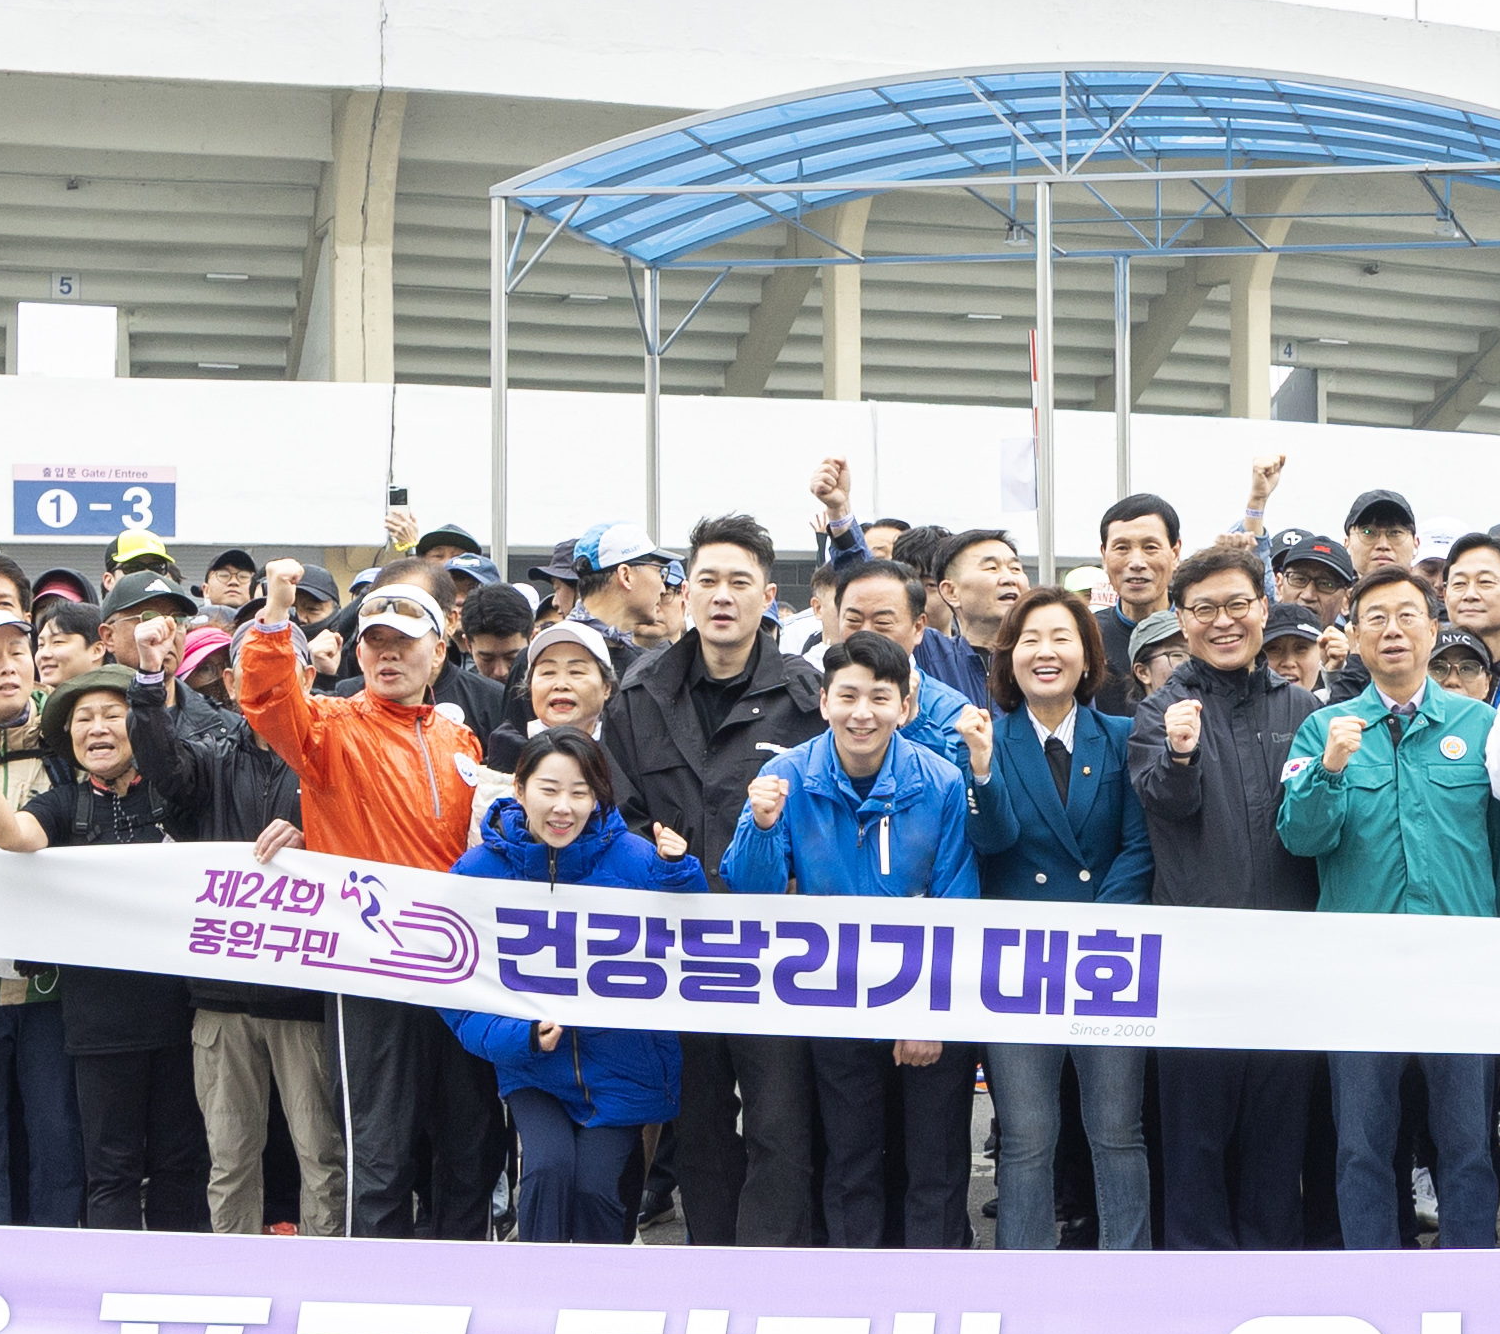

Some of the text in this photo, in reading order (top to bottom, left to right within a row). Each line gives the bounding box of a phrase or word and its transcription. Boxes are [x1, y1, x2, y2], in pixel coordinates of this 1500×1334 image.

[59, 276, 73, 295] 5
[1283, 342, 1293, 359] 4
[82, 469, 106, 479] Gate
[115, 469, 149, 479] Entree
[121, 486, 154, 530] 3
[1442, 634, 1472, 646] NYC
[195, 869, 326, 917] 제24회
[188, 916, 340, 967] 중원구민
[495, 907, 1162, 1018] 건강달리기 대회
[1069, 1021, 1156, 1038] Since 2000
